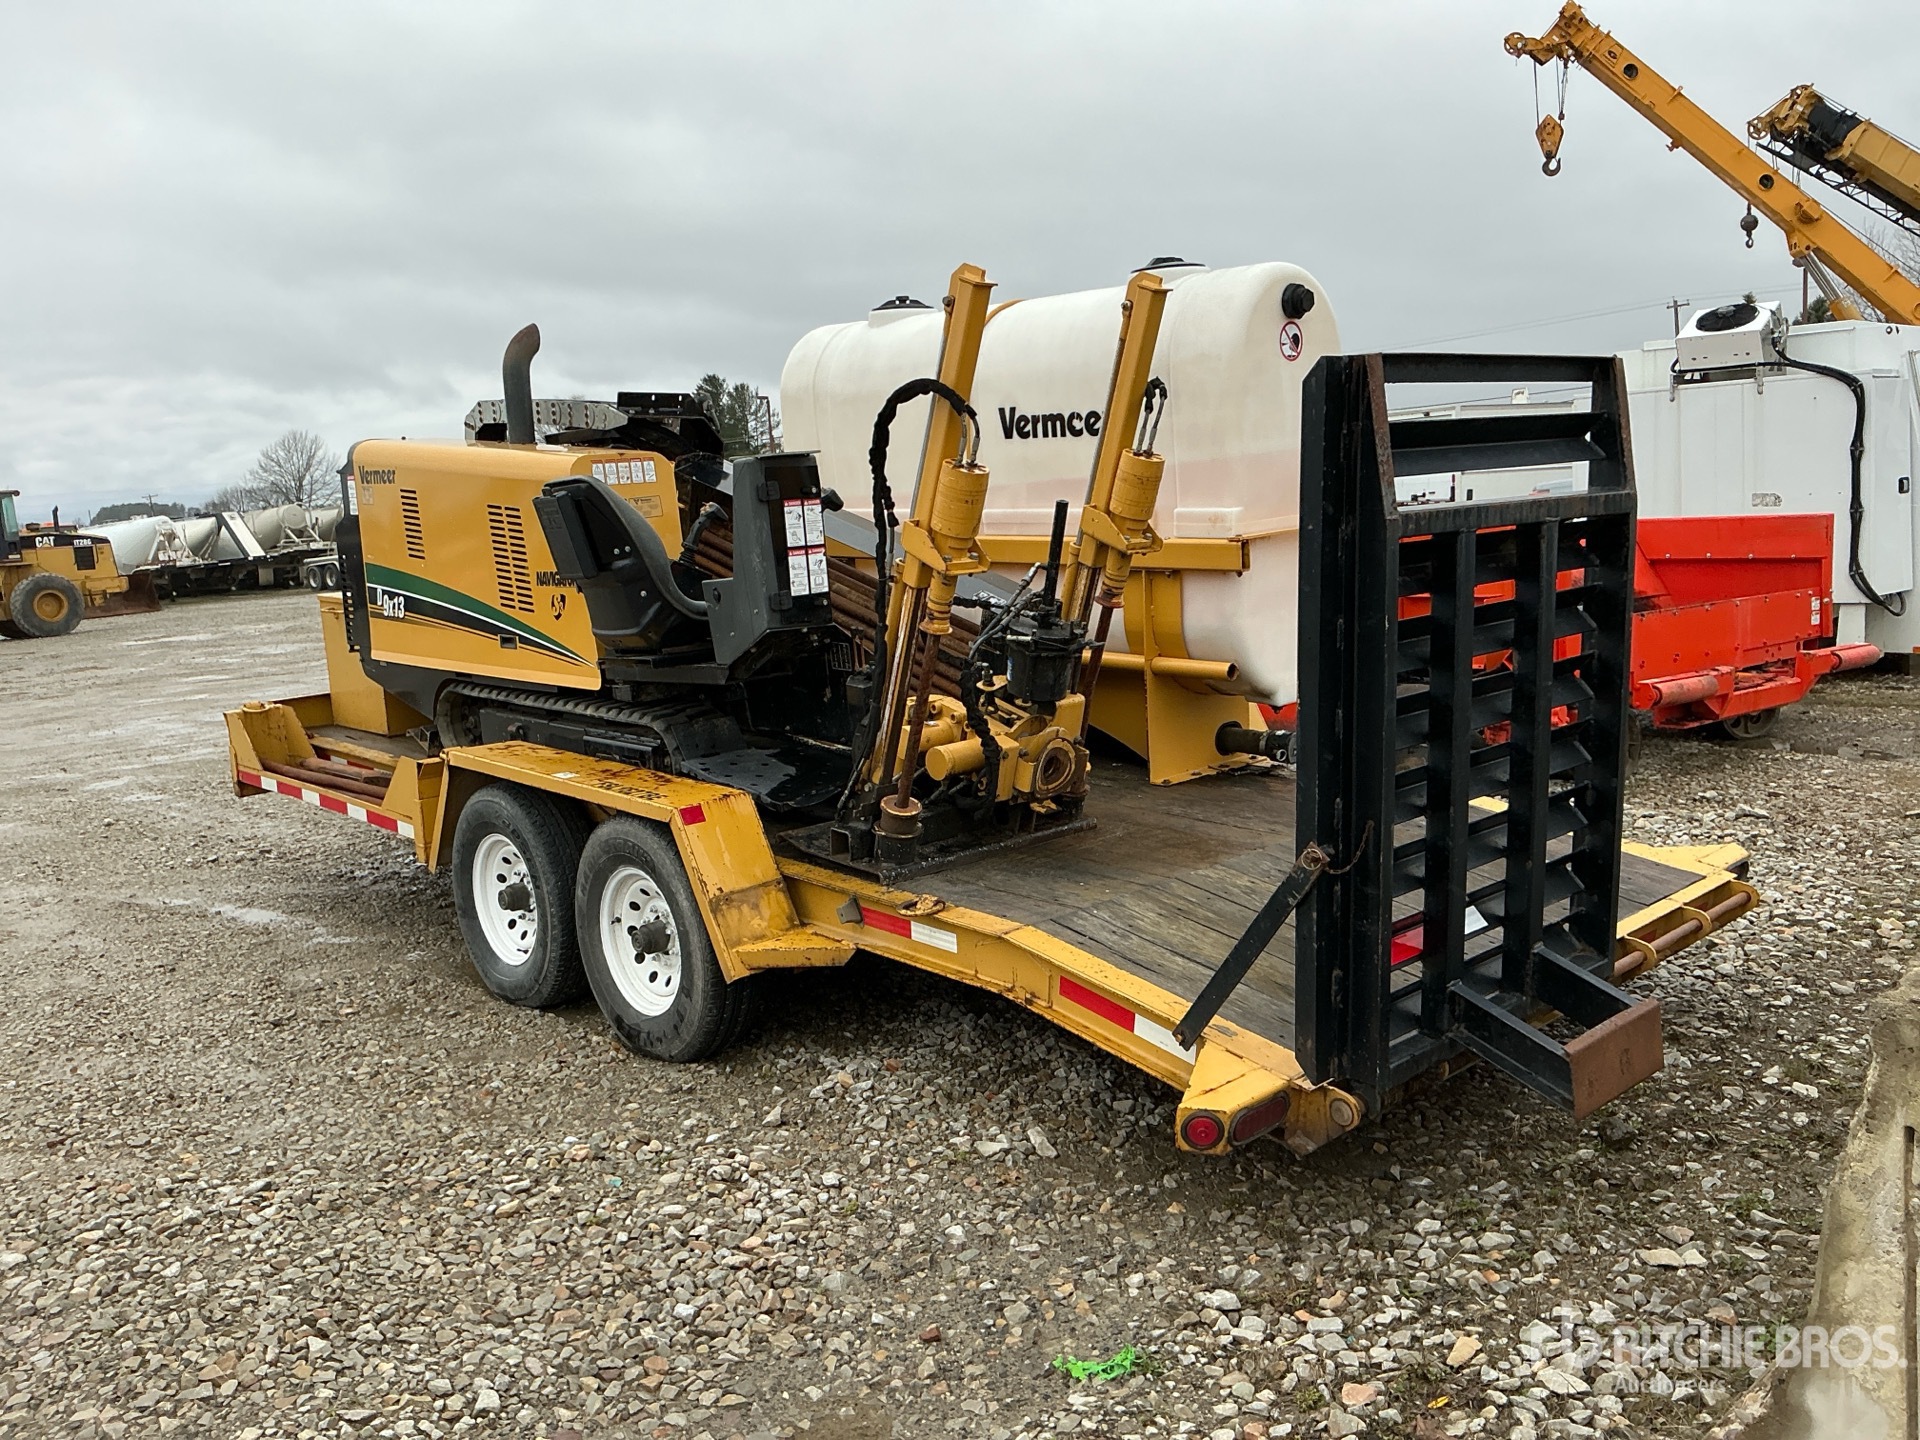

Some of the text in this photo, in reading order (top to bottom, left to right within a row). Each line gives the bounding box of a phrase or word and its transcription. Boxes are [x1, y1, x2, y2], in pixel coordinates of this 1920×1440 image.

[997, 406, 1102, 440] Vermee
[358, 465, 396, 485] Vermeer
[35, 536, 56, 548] CAT
